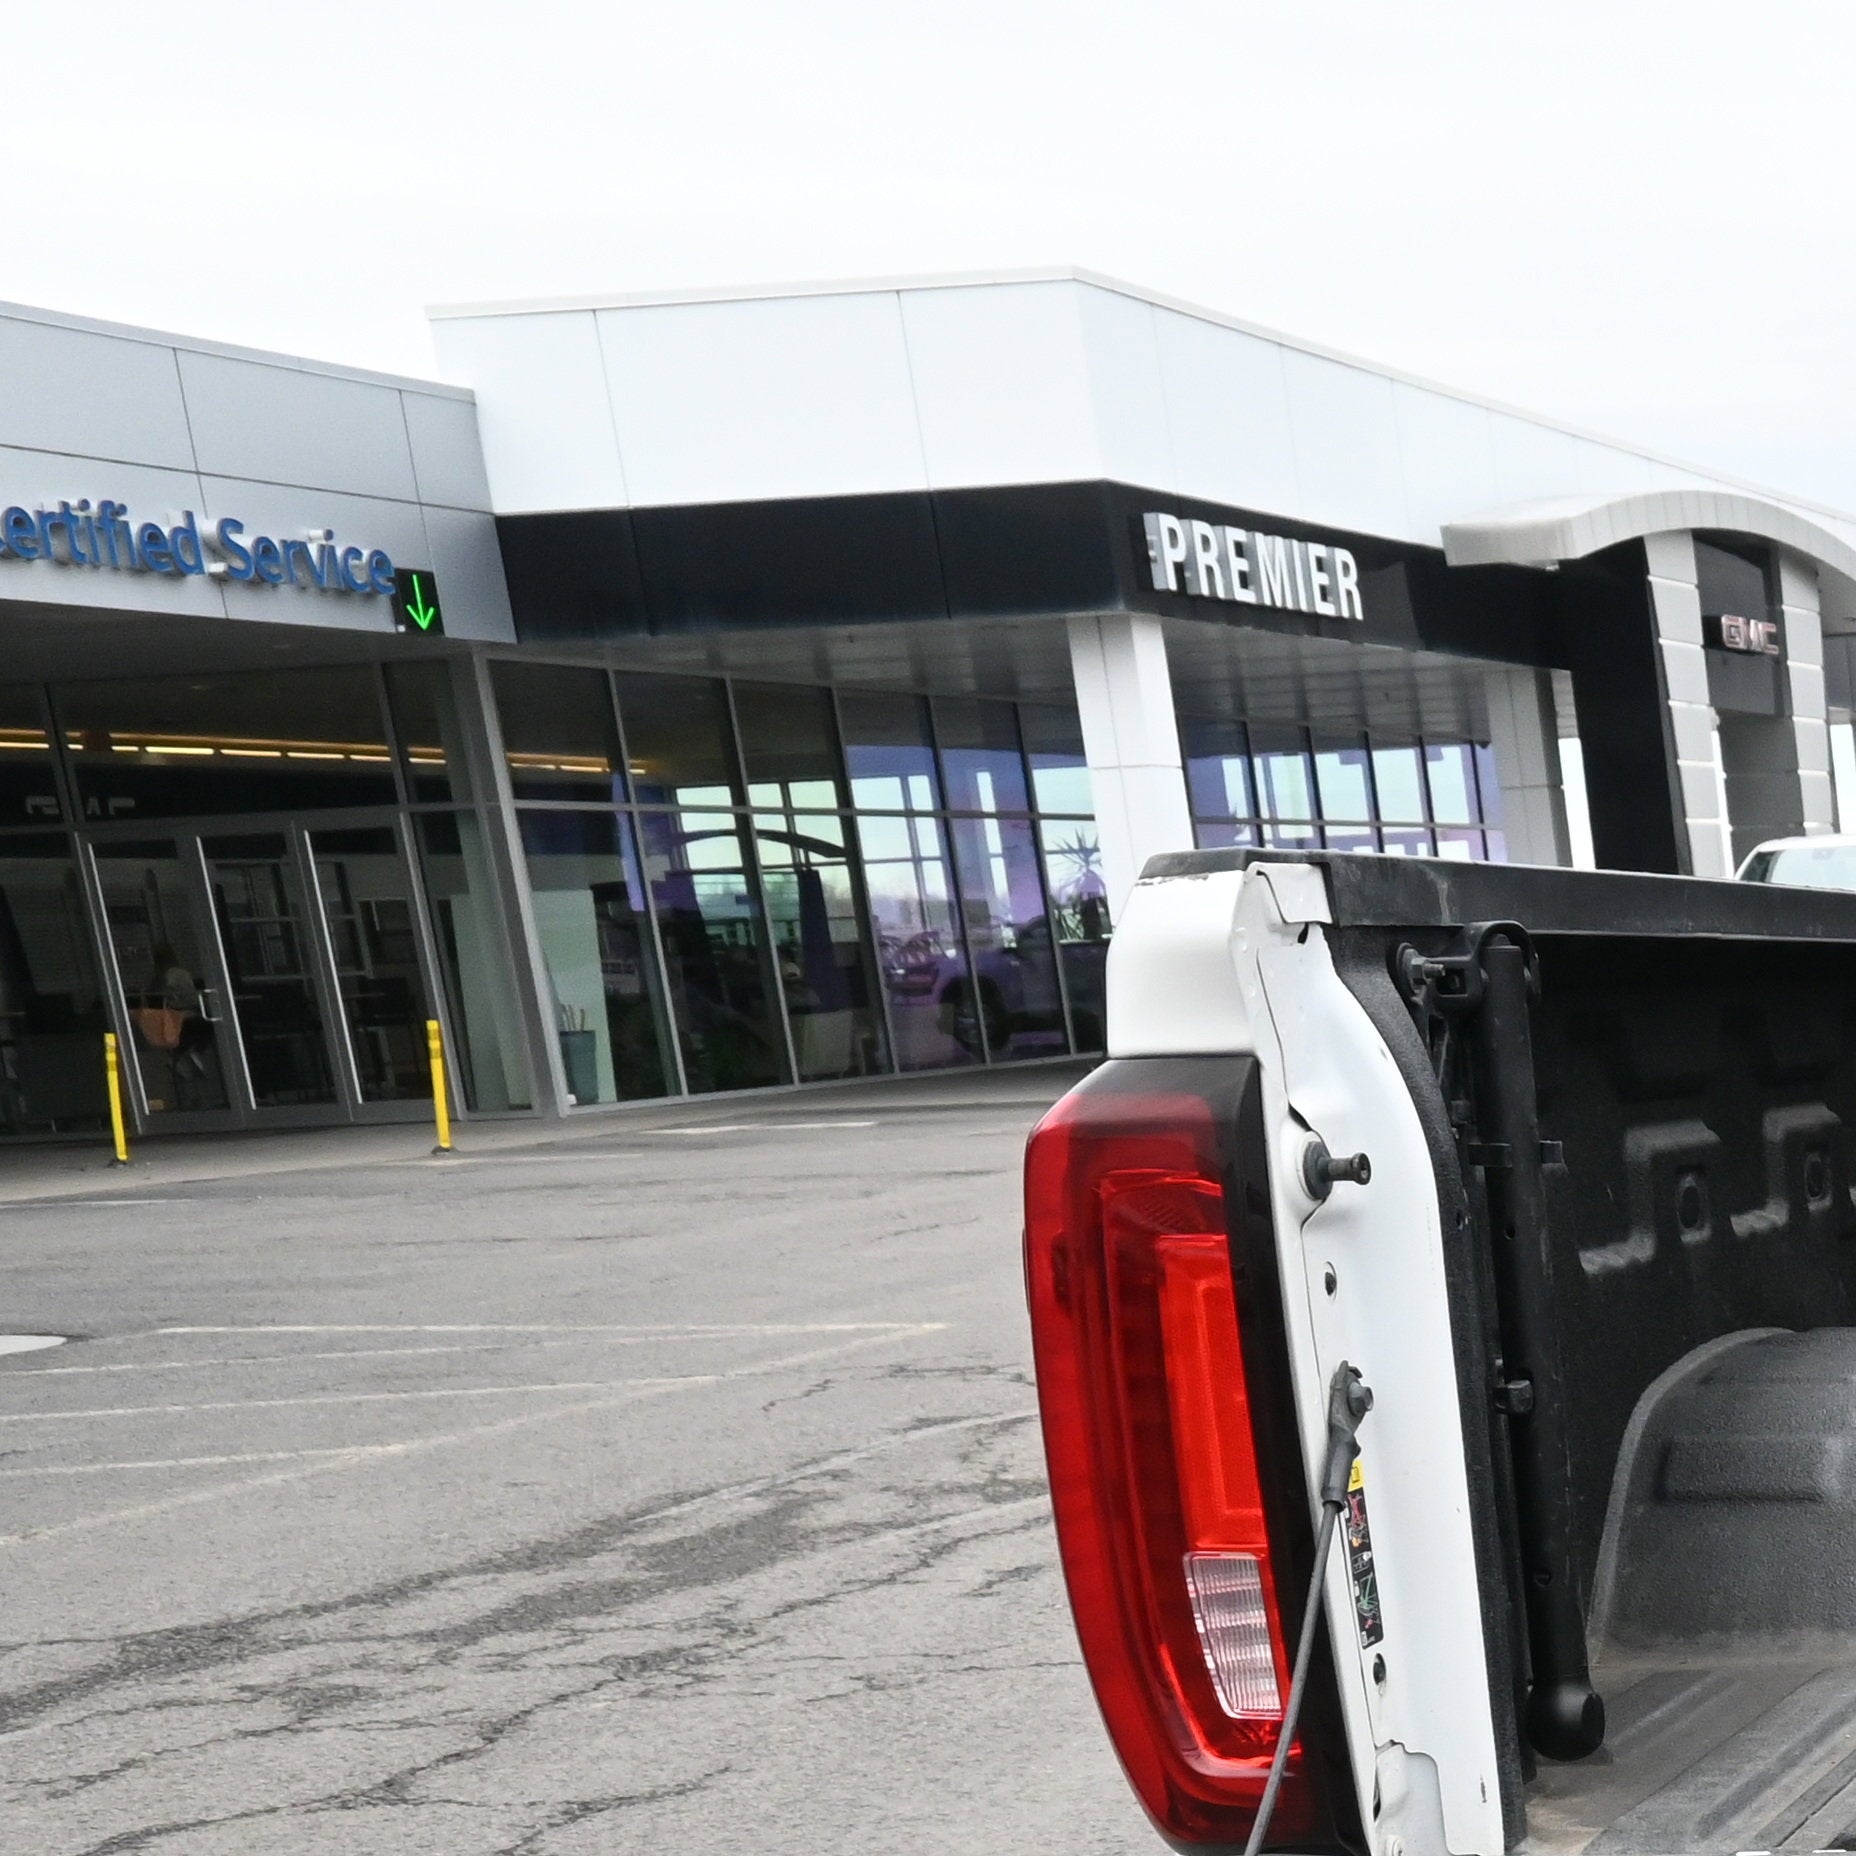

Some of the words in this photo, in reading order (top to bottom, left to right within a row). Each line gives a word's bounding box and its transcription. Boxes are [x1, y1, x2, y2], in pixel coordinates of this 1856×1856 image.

[0, 499, 206, 576] ertified
[216, 517, 397, 596] Service
[1147, 512, 1364, 621] PREMIER
[1720, 613, 1780, 656] GMC
